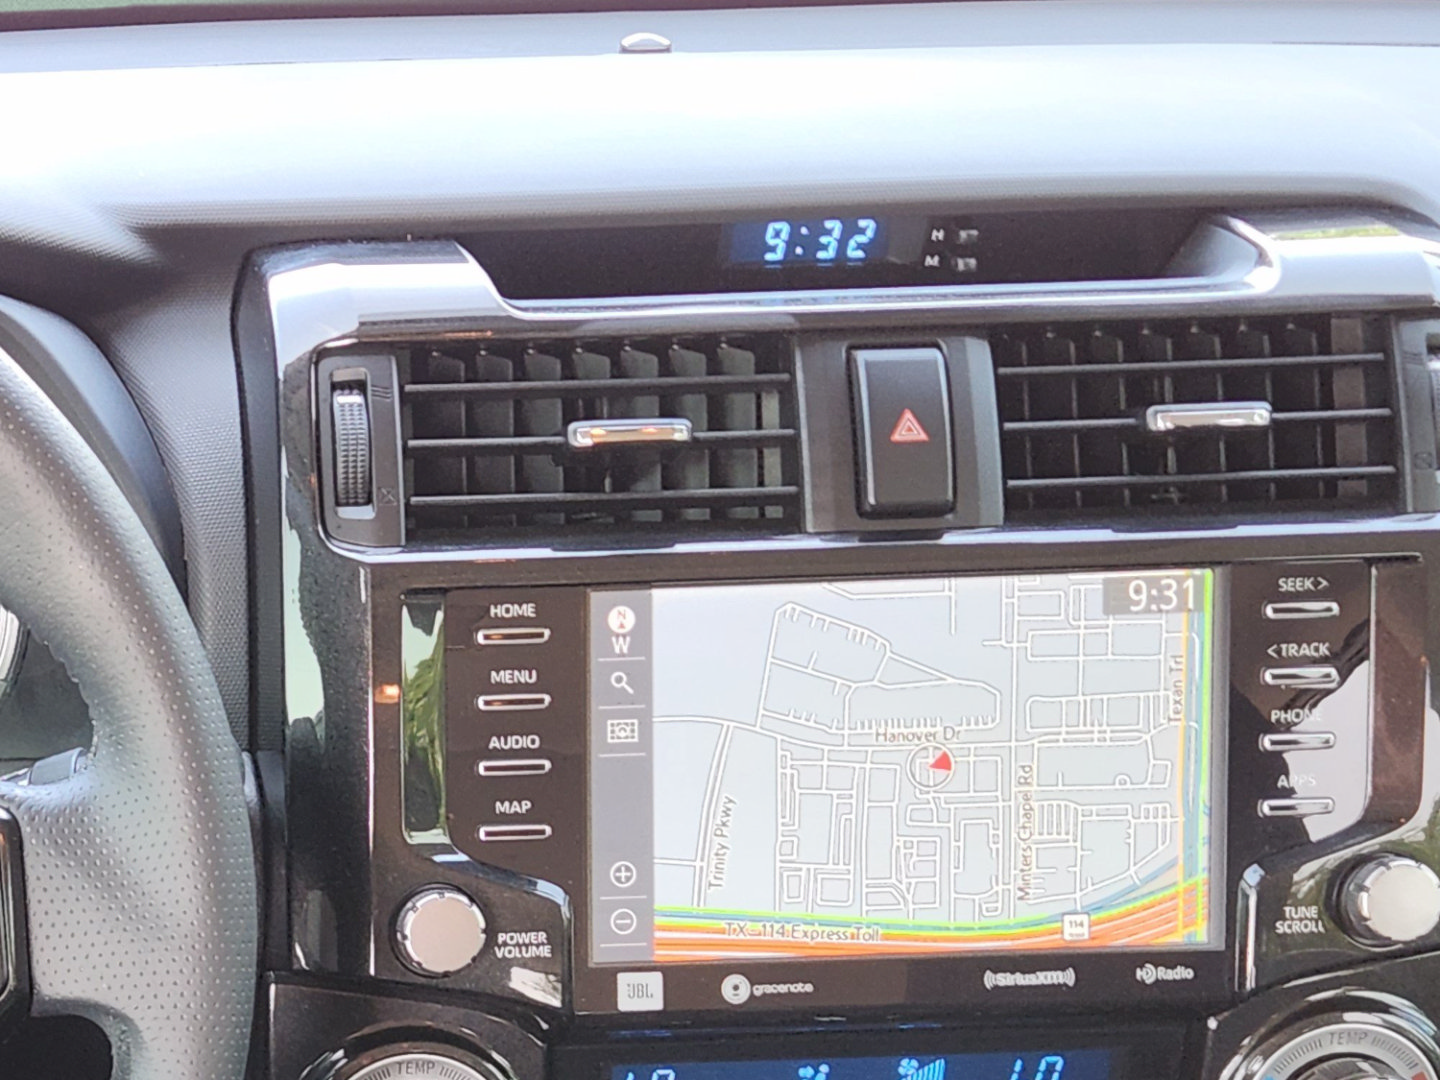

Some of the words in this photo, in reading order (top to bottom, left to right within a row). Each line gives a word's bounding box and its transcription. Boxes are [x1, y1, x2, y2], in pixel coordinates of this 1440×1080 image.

[763, 219, 877, 262] 9:32
[1128, 577, 1196, 612] 9:31
[489, 603, 537, 619] HOME
[611, 636, 631, 654] W
[1168, 654, 1184, 675] Trl
[490, 669, 537, 685] MENU
[1168, 679, 1185, 724] Texan
[1271, 708, 1323, 725] PHONE
[488, 734, 540, 751] AUDIO
[875, 726, 938, 743] Hanover
[943, 725, 961, 741] Dr
[1018, 764, 1033, 786] Rd
[495, 800, 532, 816] MAP
[1017, 789, 1034, 842] Chapel
[713, 795, 737, 839] Pkwy
[708, 842, 731, 891] Trinity
[1017, 845, 1033, 901] Minters
[1283, 905, 1319, 920] TUNE
[1068, 919, 1085, 930] 114
[1275, 919, 1325, 935] SCROLL
[497, 930, 548, 945] POWER
[791, 924, 849, 943] Express
[854, 926, 880, 942] Toll
[494, 943, 552, 959] VOLUME
[1158, 965, 1196, 981] Radio
[626, 982, 654, 999] JBL
[752, 982, 814, 997] gracenote
[1327, 1031, 1370, 1046] TEMP
[395, 1060, 437, 1076] TEMP
